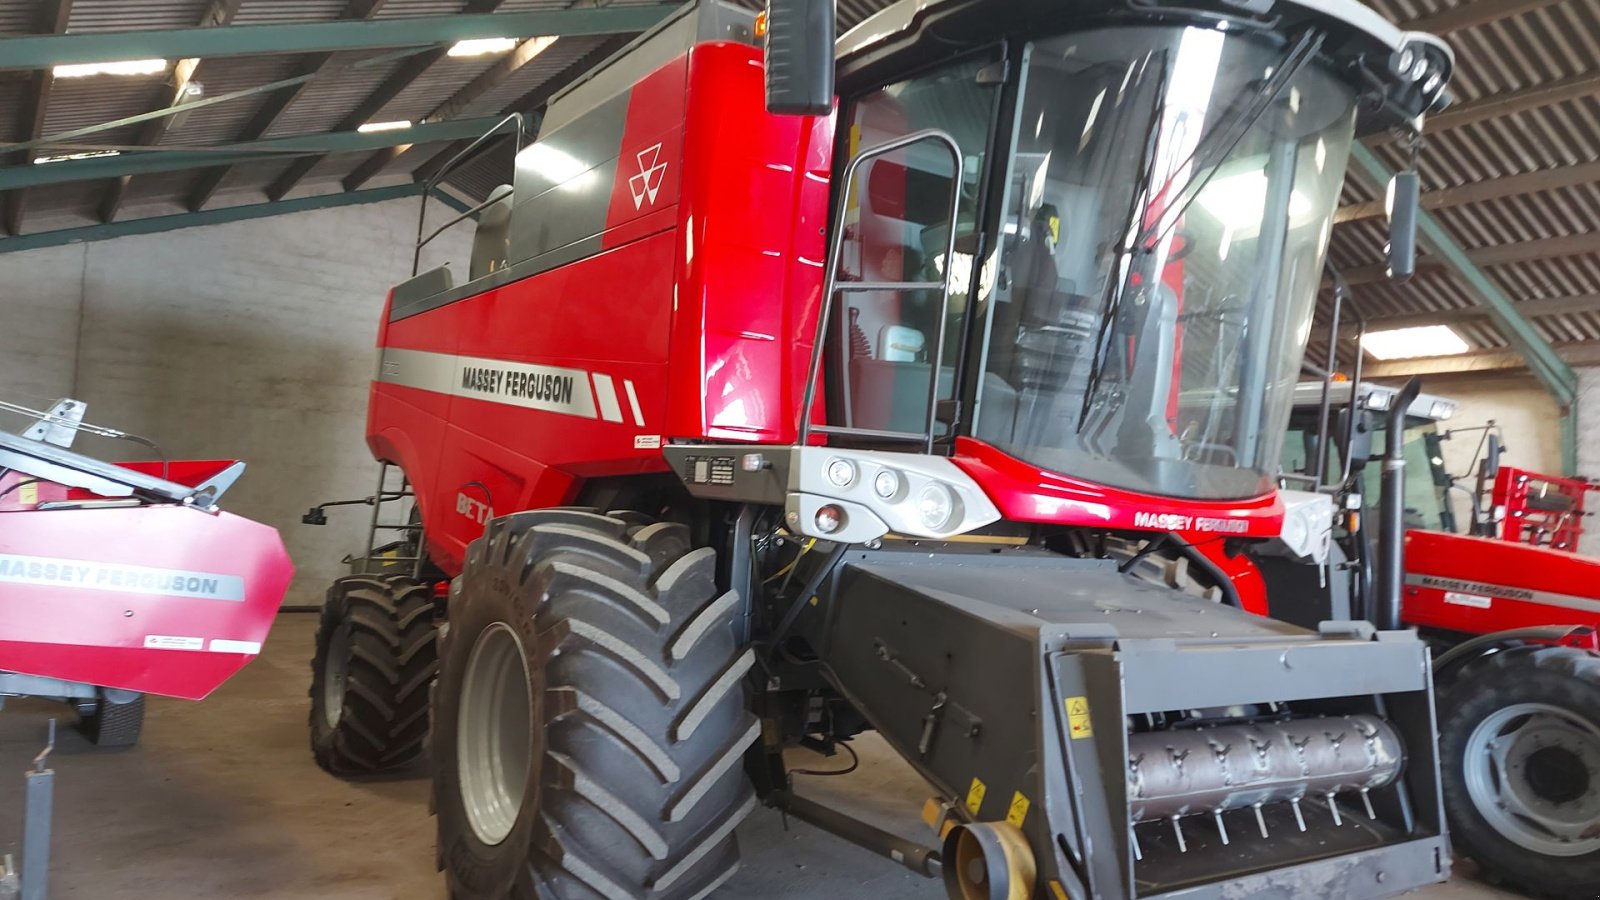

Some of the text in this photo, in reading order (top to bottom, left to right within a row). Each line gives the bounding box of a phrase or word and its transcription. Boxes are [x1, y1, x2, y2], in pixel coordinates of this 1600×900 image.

[462, 366, 574, 404] MASSEY FERGUSON
[456, 492, 495, 525] BETA
[1134, 511, 1193, 531] MASSEY
[95, 568, 219, 595] FERGUSON
[1422, 576, 1469, 592] MASSEY
[1471, 583, 1534, 600] FERGUSON
